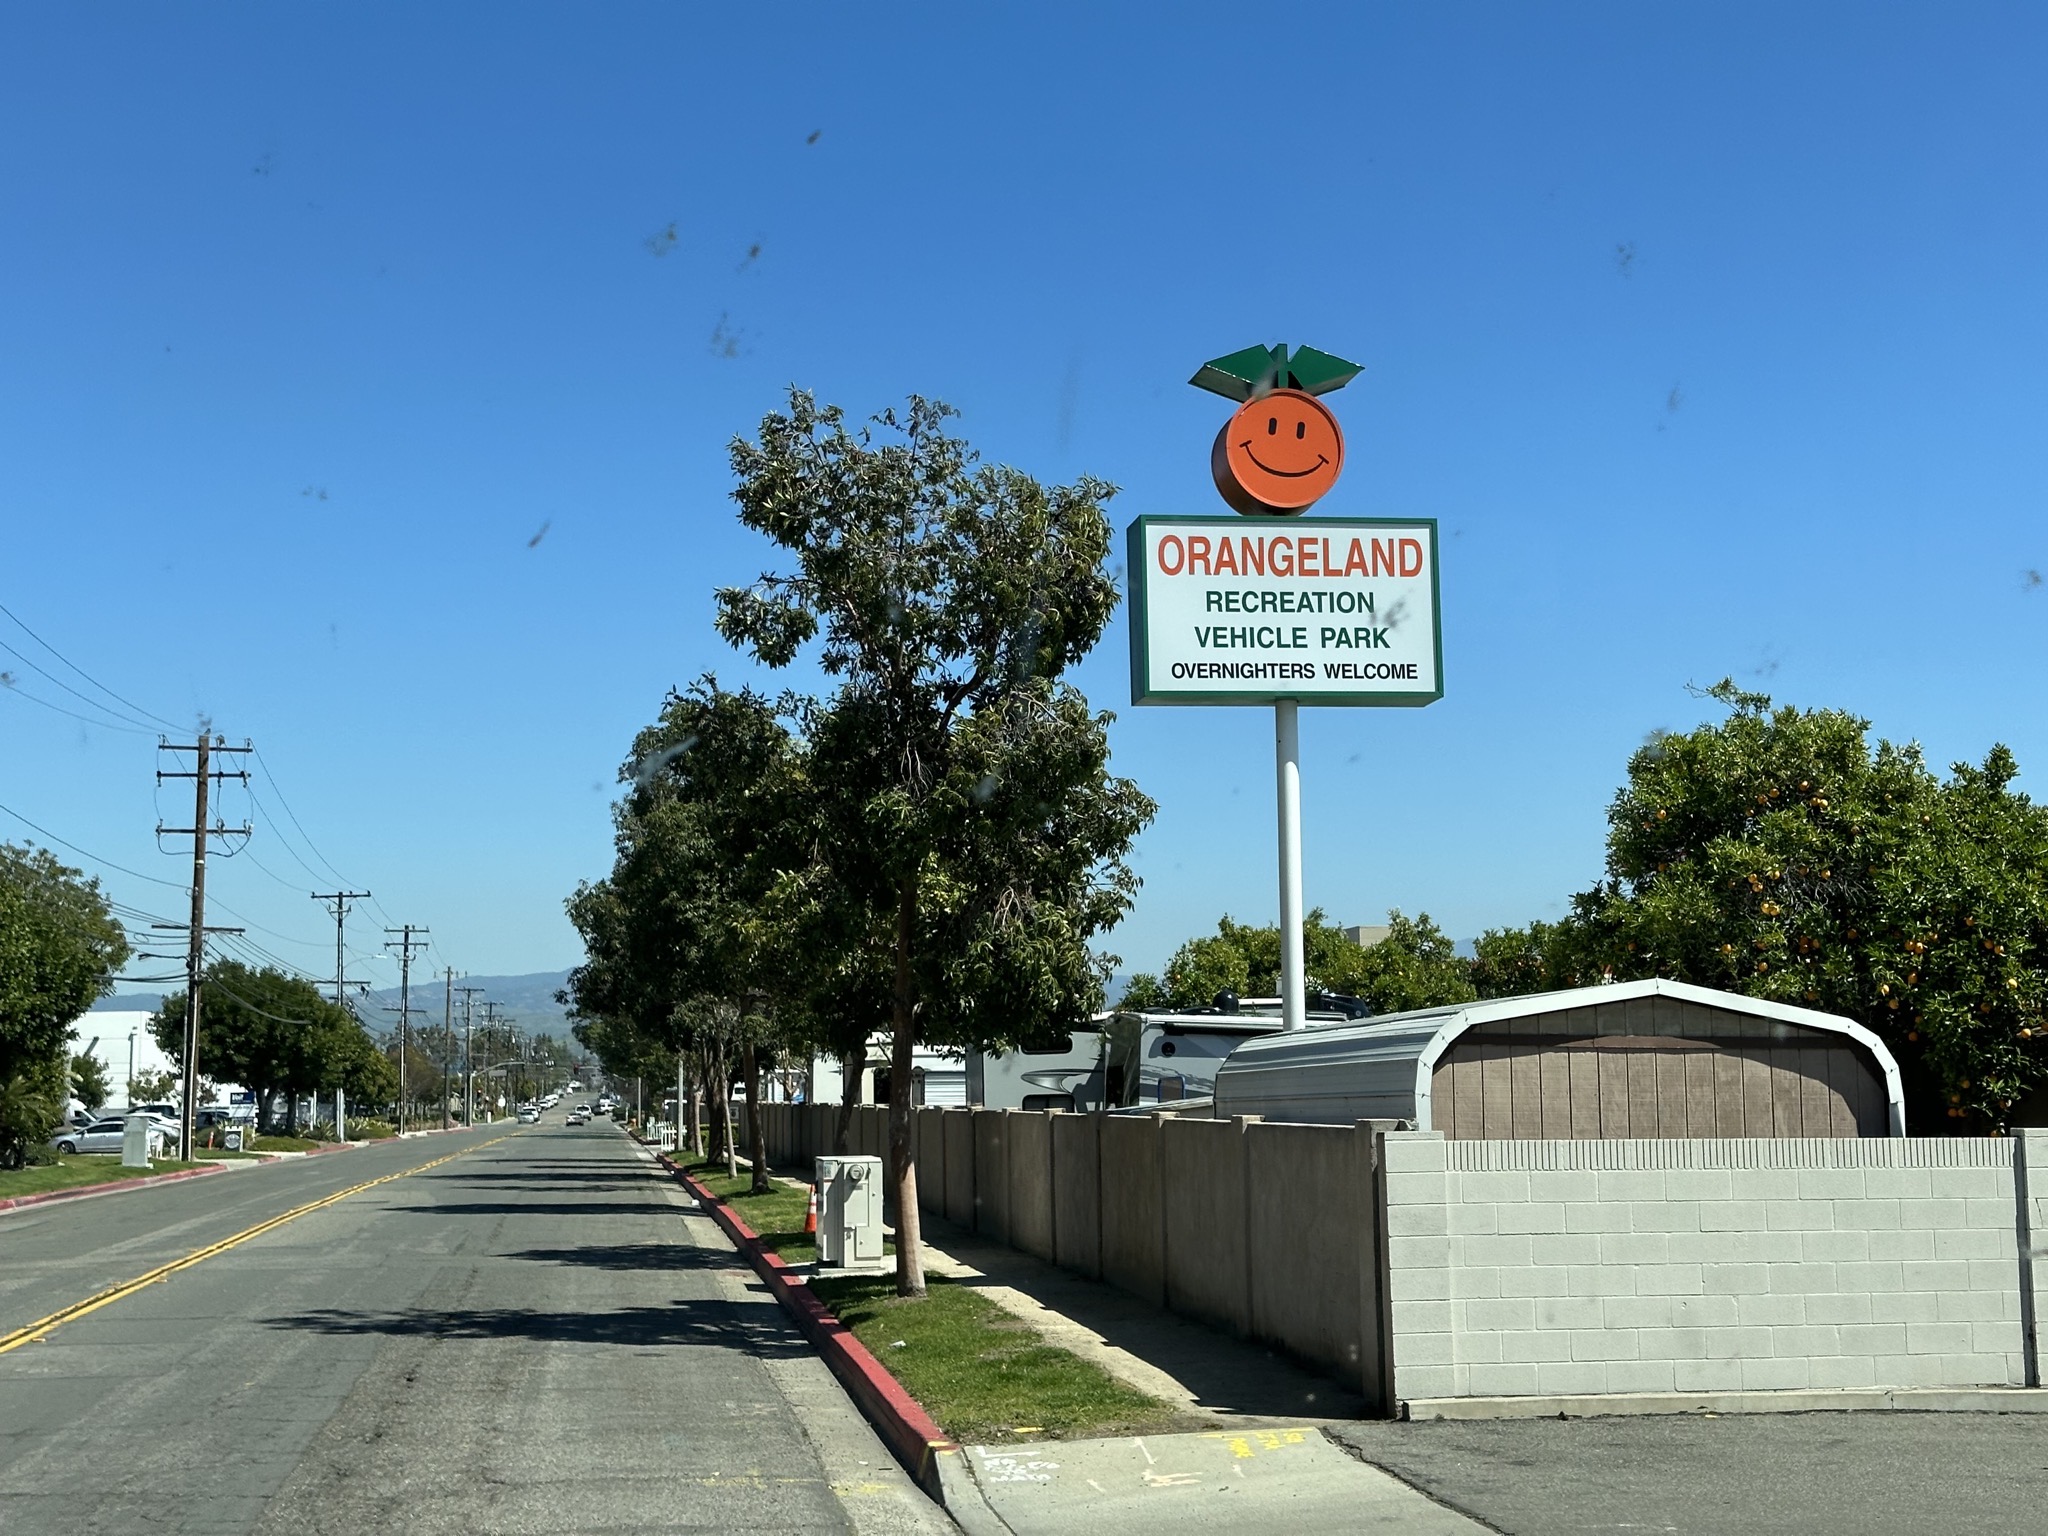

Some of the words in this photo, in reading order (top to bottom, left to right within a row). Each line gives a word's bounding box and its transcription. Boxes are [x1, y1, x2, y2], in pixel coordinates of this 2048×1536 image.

[1158, 534, 1423, 577] ORANGELAND
[1206, 591, 1375, 613] RECREATION
[1194, 626, 1308, 648] VEHICLE
[1321, 627, 1391, 649] PARK
[1171, 662, 1316, 680] OVERNIGHTERS
[1323, 663, 1419, 680] WELCOME
